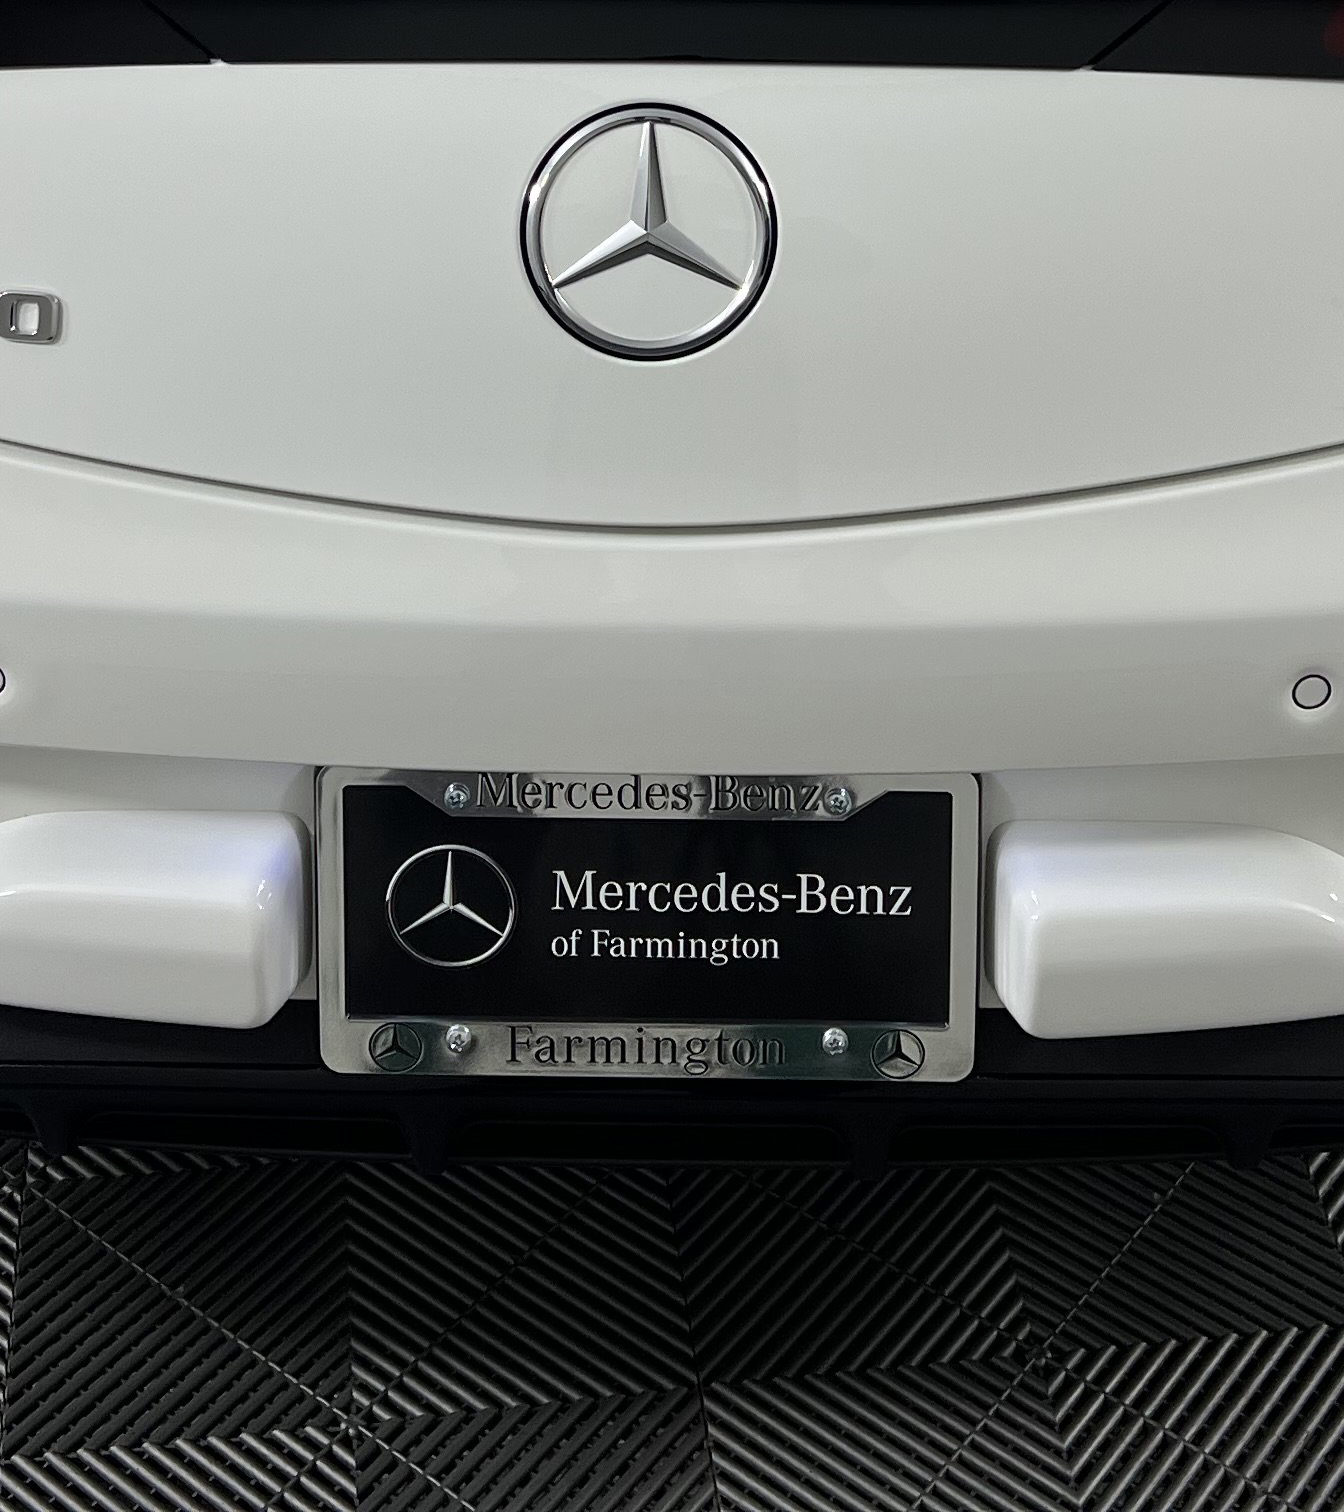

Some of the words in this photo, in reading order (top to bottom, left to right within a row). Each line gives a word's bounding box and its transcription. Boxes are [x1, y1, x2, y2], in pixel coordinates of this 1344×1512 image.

[476, 773, 822, 813] Mercedes-Benz
[551, 870, 912, 916] Mercedes-Benz
[551, 929, 581, 957] of
[591, 929, 780, 966] Farmington
[506, 1025, 786, 1075] Farmington
